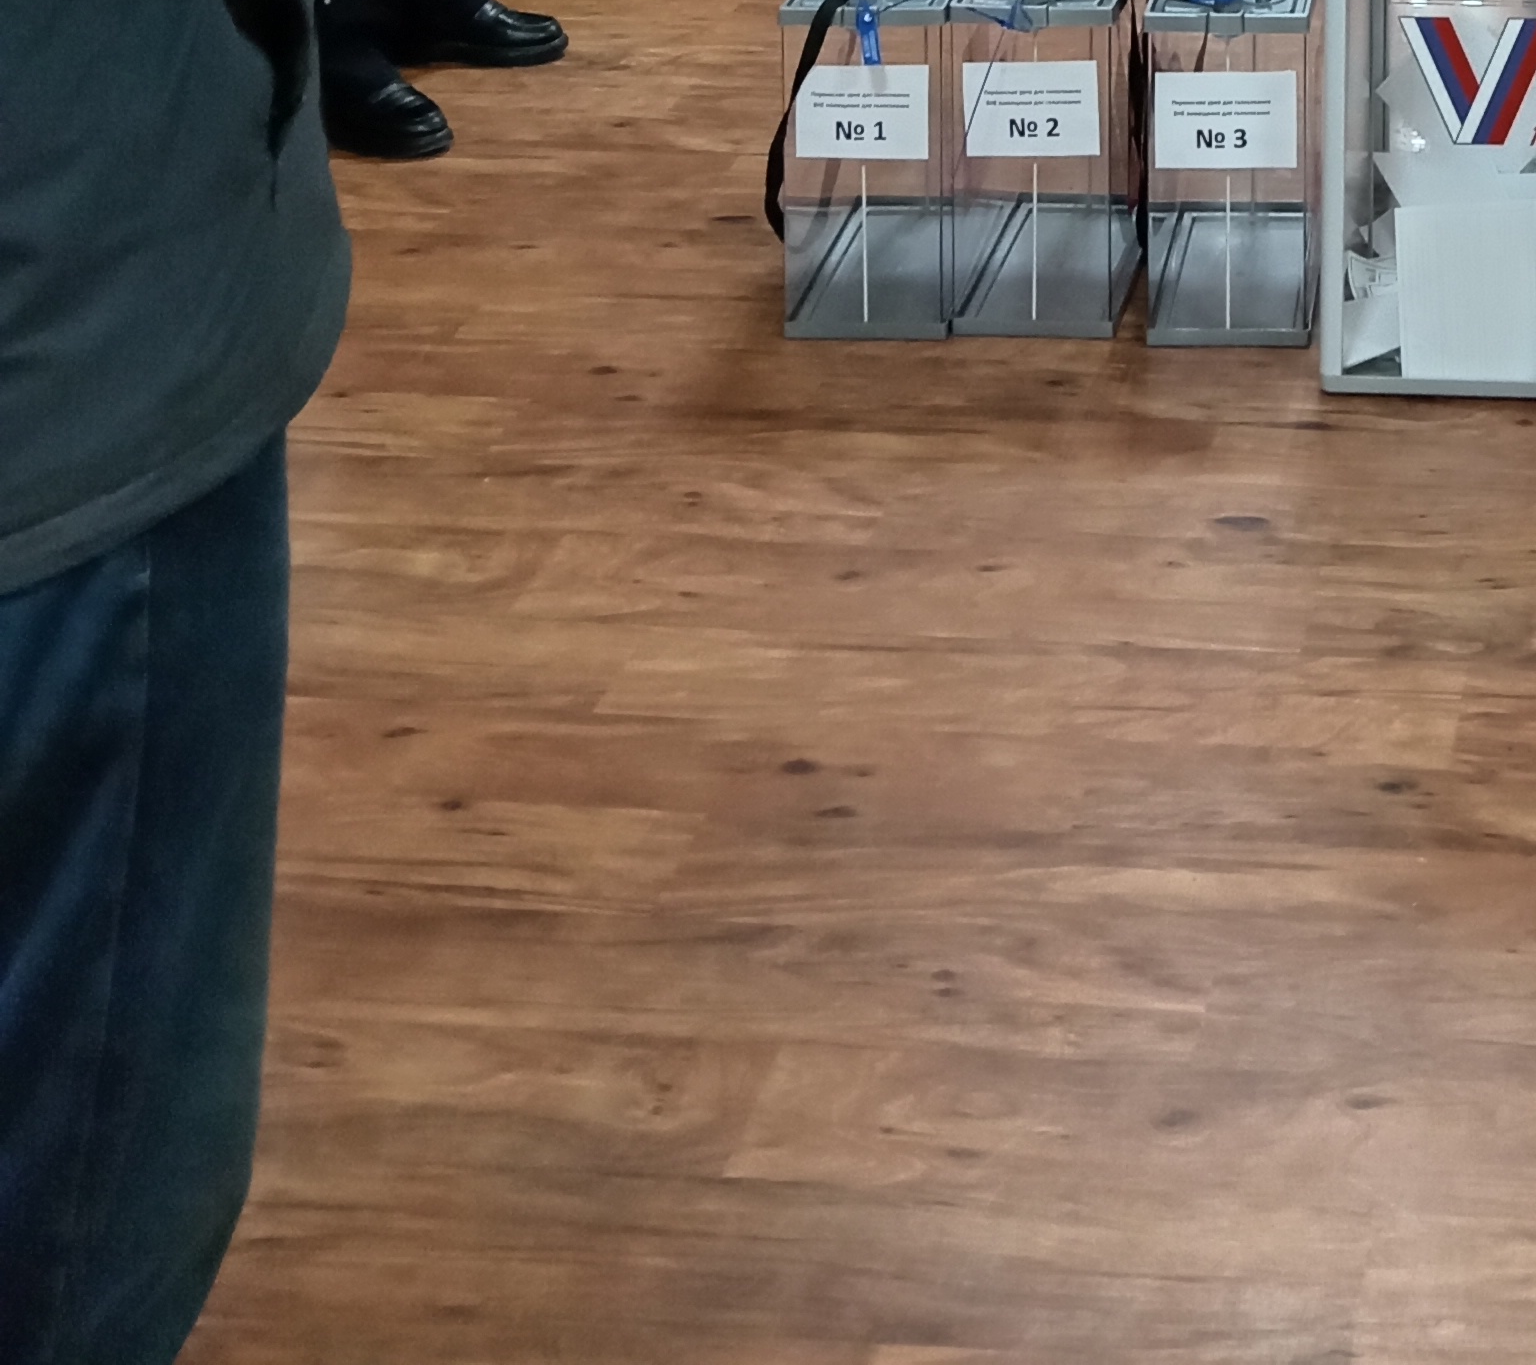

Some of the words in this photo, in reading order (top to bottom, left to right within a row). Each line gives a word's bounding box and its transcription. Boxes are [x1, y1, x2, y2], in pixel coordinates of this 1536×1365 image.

[873, 120, 887, 141] 1
[1045, 117, 1061, 138] 2
[1233, 128, 1248, 149] 3
